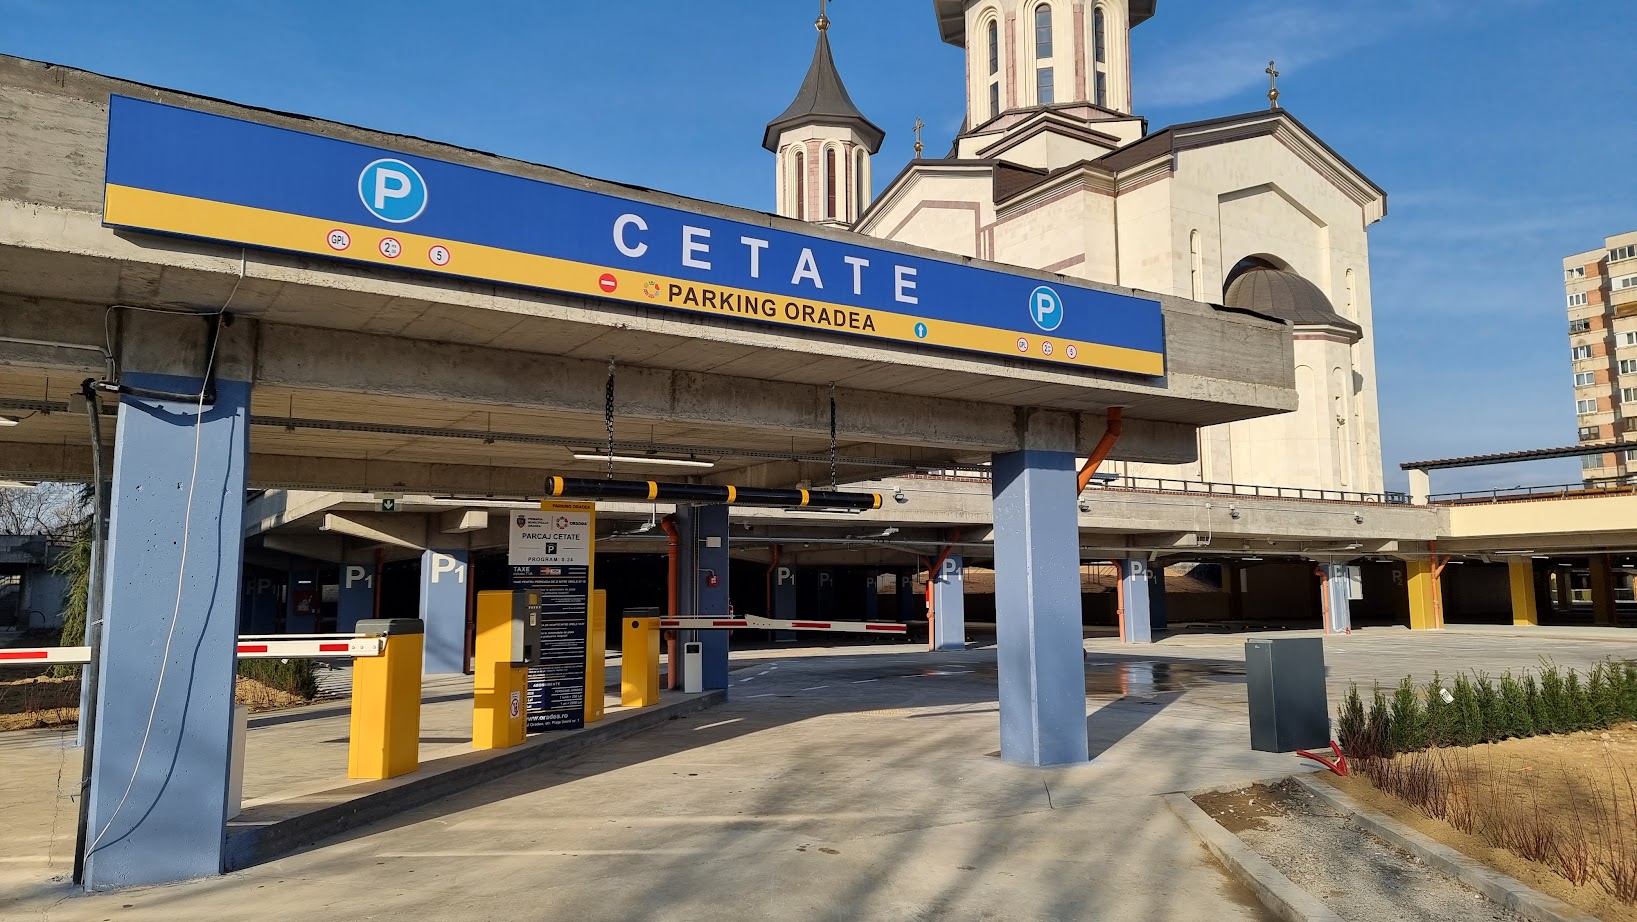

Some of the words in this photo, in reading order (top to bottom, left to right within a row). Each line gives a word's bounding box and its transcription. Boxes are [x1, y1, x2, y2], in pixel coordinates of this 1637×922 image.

[374, 167, 412, 209] P
[331, 234, 346, 246] GPL
[436, 250, 443, 261] 5
[612, 213, 919, 304] CETATE
[668, 283, 776, 318] PARKING
[784, 302, 876, 332] ORADEA
[1036, 292, 1056, 322] P
[522, 532, 552, 540] PARCAJ
[553, 533, 580, 541] CETATE
[548, 545, 555, 553] P
[345, 565, 372, 589] P1
[431, 553, 465, 584] P1
[777, 566, 795, 586] P1
[943, 558, 962, 581] P1
[1131, 560, 1147, 582] P1
